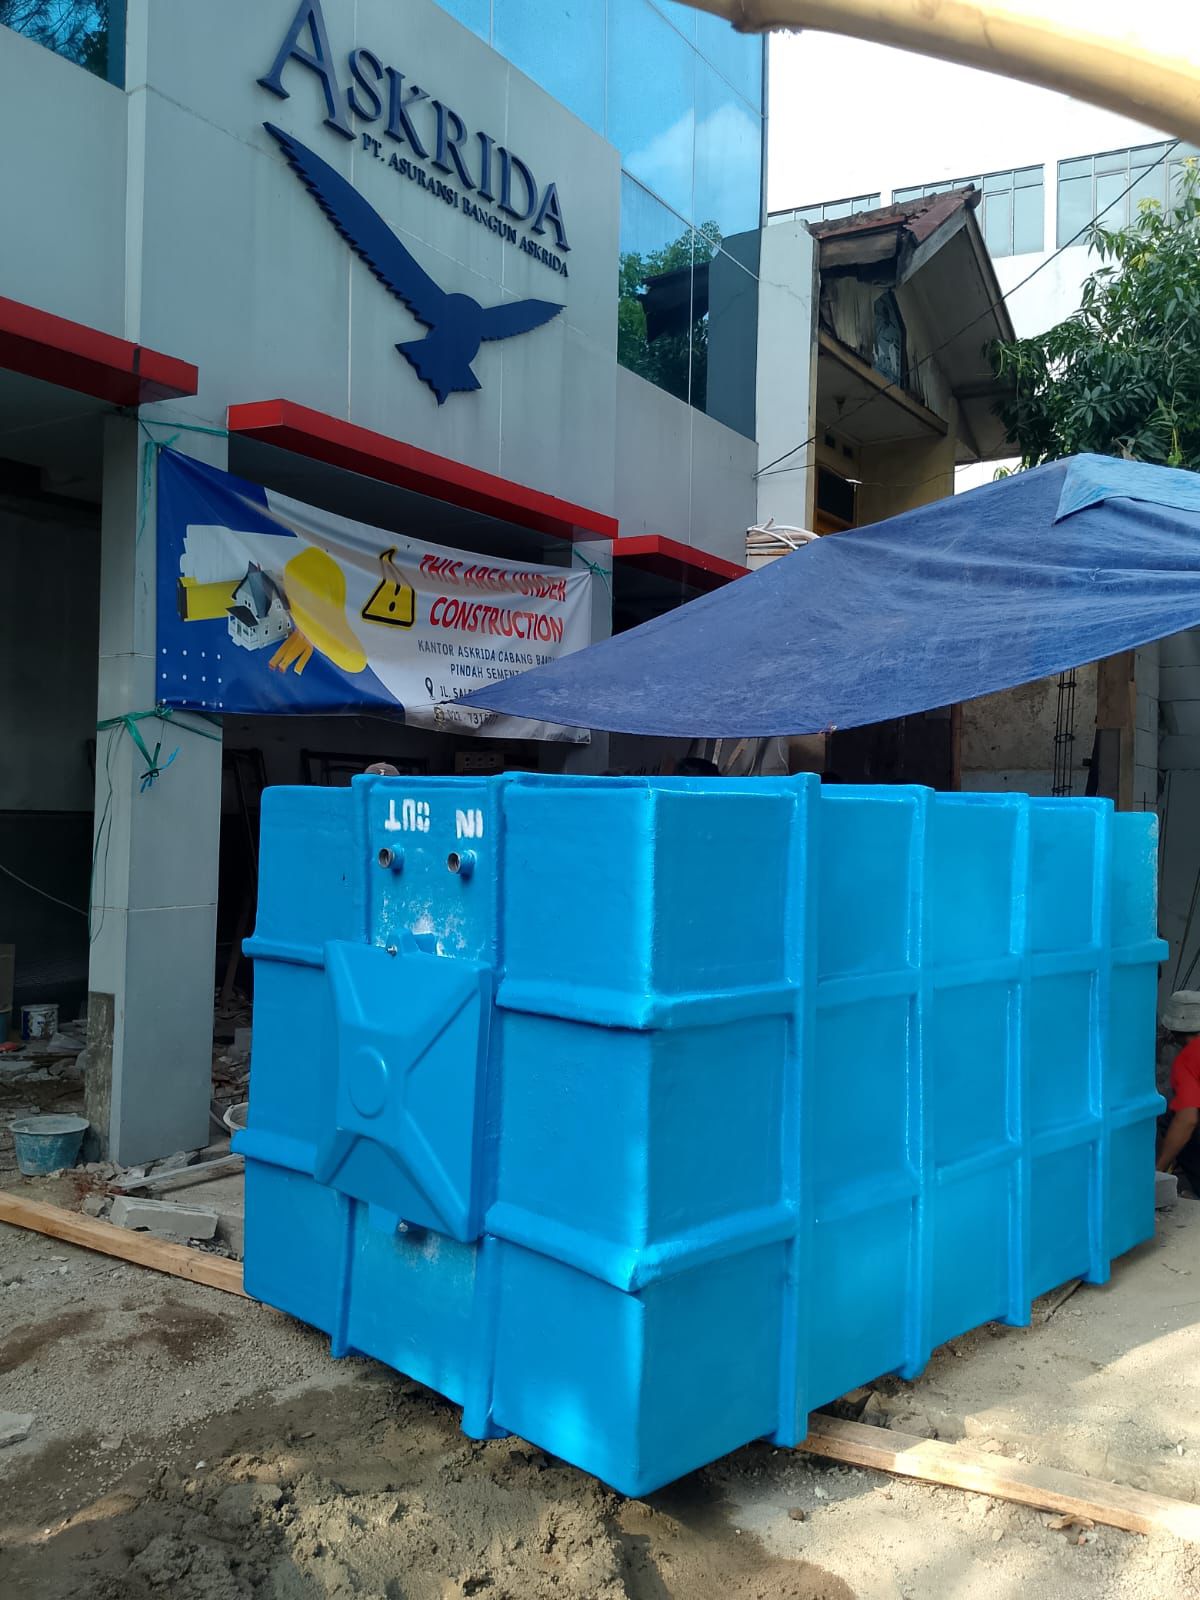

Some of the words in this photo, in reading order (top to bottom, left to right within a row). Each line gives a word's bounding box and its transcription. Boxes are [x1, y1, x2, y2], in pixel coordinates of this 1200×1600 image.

[257, 0, 571, 252] ASKRIDA
[362, 133, 385, 162] PT.
[388, 152, 459, 208] ASURANSI
[462, 199, 517, 245] BANGUN
[519, 236, 568, 277] ASKRIDA
[419, 554, 463, 584] THIS
[464, 565, 509, 590] AREA
[510, 571, 567, 602] UNDER
[430, 596, 564, 644] CONSTRUCTION
[418, 639, 454, 657] KANTOR
[458, 646, 496, 662] ASKRIDA
[498, 651, 533, 665] CABANG
[450, 663, 484, 679] PINDAH
[487, 668, 522, 680] SEMENT
[384, 798, 430, 833] OUT
[455, 808, 484, 839] IN
